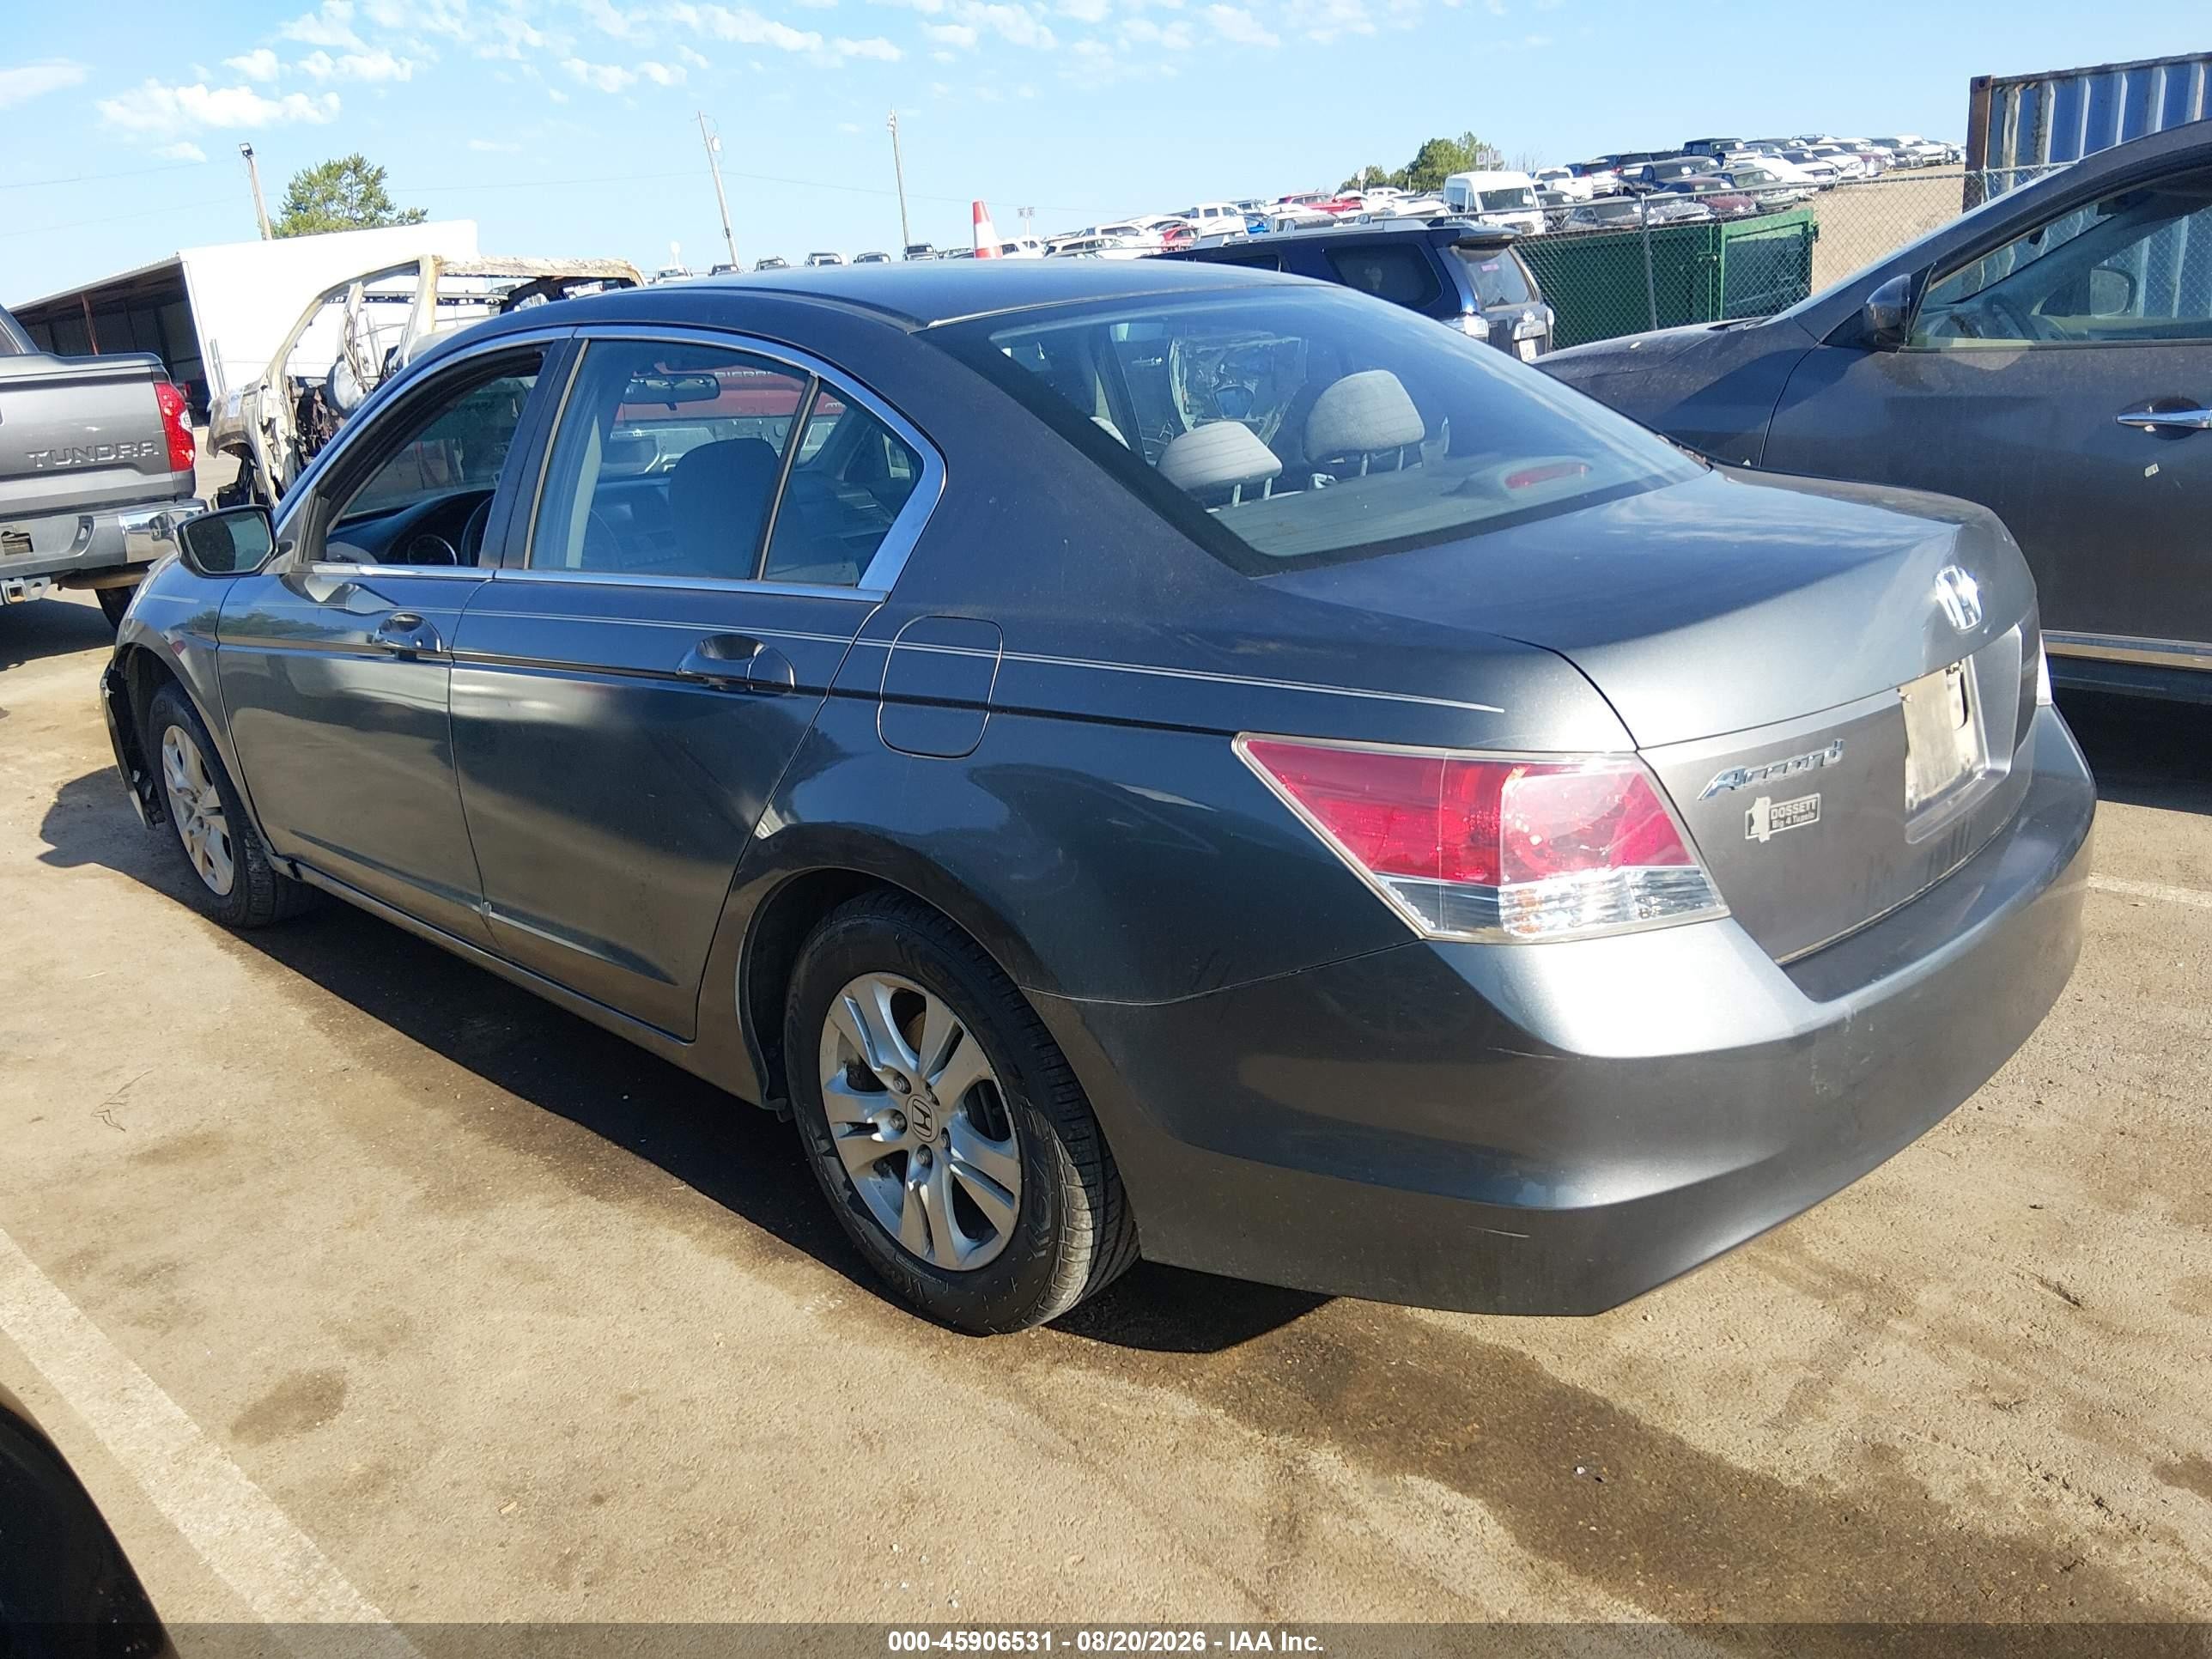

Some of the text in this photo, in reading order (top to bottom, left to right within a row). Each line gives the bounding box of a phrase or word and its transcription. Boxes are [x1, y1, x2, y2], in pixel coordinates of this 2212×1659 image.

[26, 440, 160, 468] TUNDRA
[1696, 738, 1845, 801] Accord
[1770, 798, 1818, 821] DOSSETT
